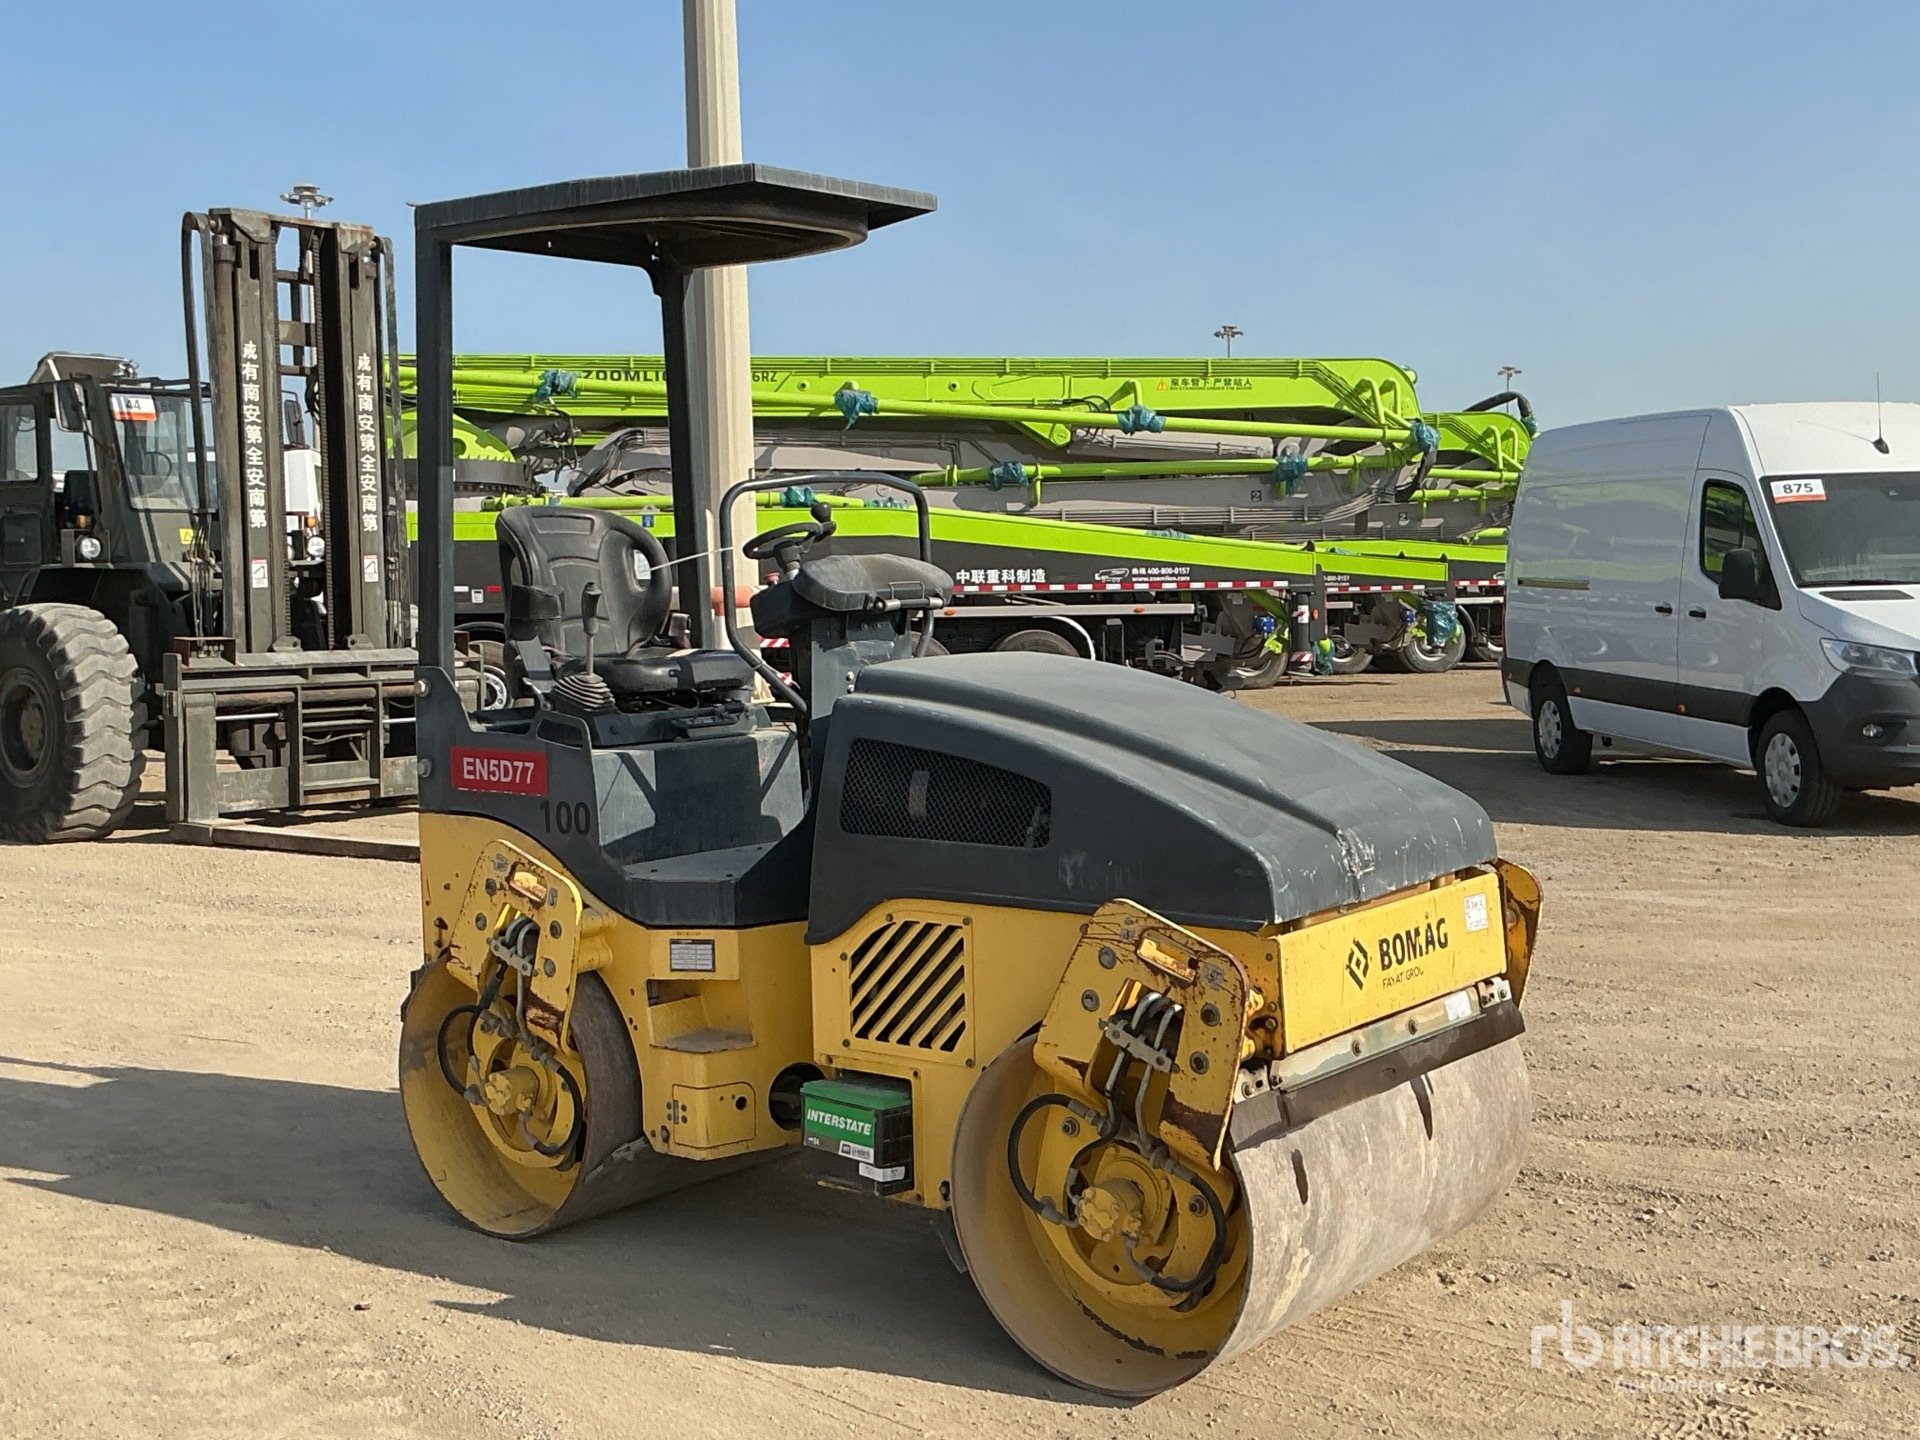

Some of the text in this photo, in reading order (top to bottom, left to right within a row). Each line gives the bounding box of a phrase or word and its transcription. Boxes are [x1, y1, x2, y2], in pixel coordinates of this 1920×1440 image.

[1252, 491, 1261, 501] 2
[1782, 483, 1814, 494] 875
[1400, 512, 1408, 522] 2
[956, 568, 1046, 584] 中联重科制造
[463, 757, 535, 785] EN5D77
[540, 800, 591, 836] 100
[1378, 917, 1449, 972] BOMAG
[807, 1108, 872, 1136] INTERSTATE
